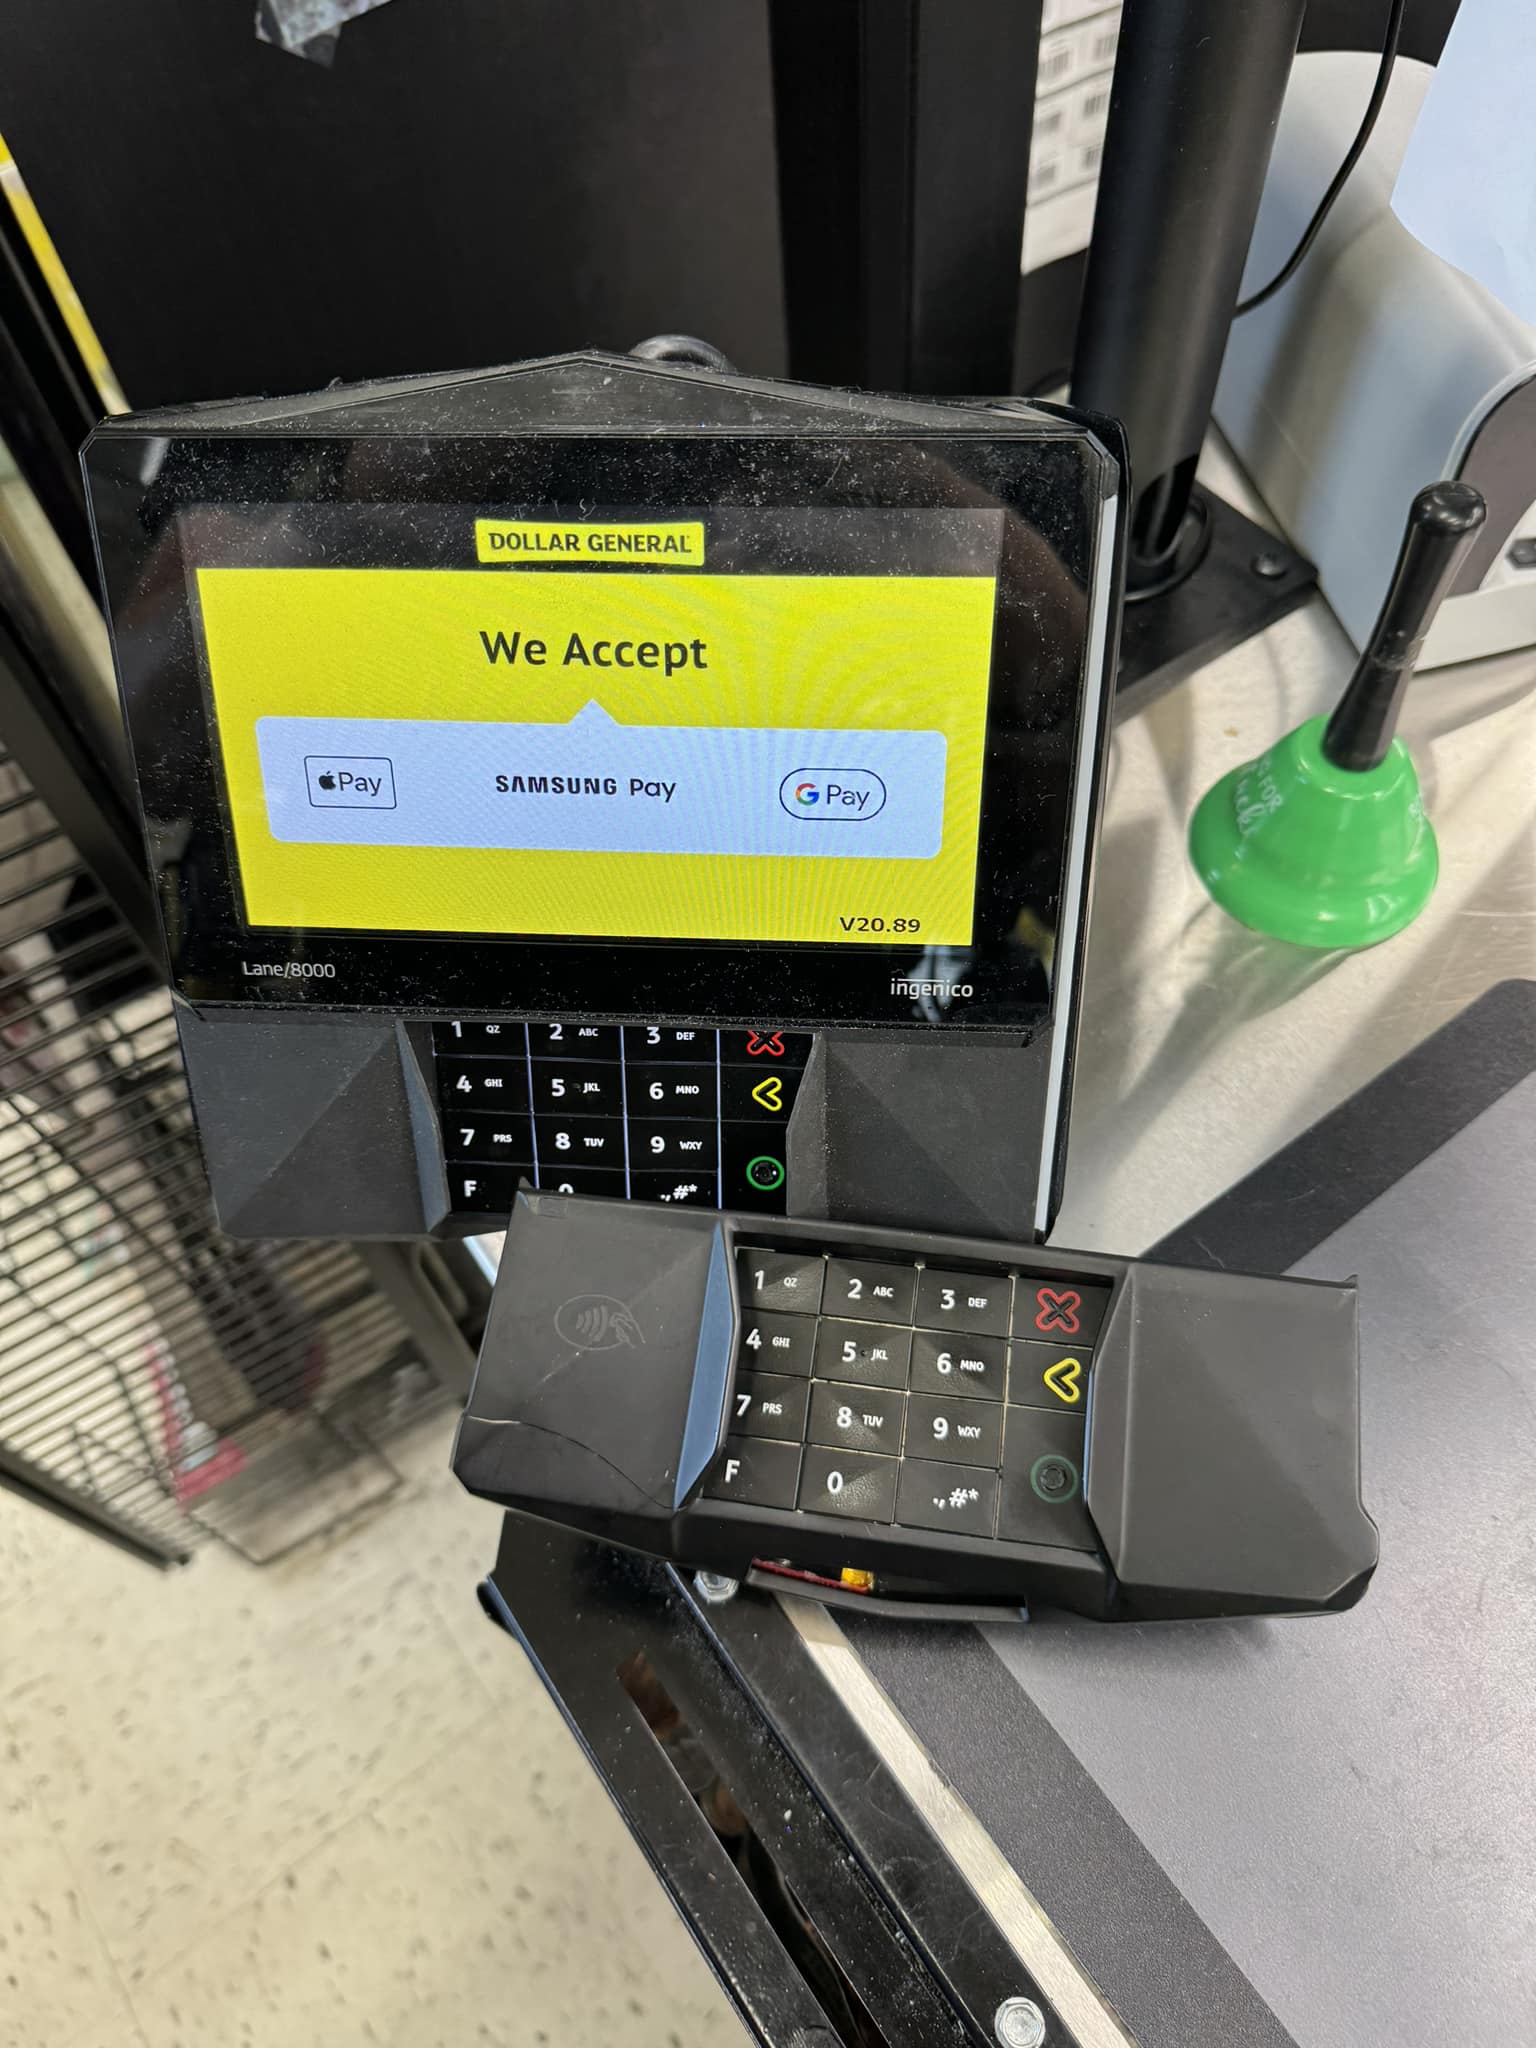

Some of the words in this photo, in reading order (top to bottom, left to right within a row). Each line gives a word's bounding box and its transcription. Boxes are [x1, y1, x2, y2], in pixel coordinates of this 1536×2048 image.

[489, 533, 580, 551] DOLLAR
[588, 534, 691, 553] GENERAL
[480, 631, 546, 665] We
[563, 633, 707, 676] Accept
[339, 772, 381, 796] Pay
[496, 775, 616, 795] SAMSUNG
[630, 779, 676, 802] Pay
[827, 785, 870, 811] Pay
[840, 917, 920, 932] V20.89
[243, 962, 335, 982] Lane/8000
[890, 977, 974, 1000] ingenico
[452, 1021, 461, 1037] 1
[486, 1025, 500, 1033] QZ
[550, 1023, 563, 1040] 2
[579, 1028, 598, 1036] ABC
[647, 1027, 660, 1044] 3
[677, 1032, 695, 1040] DEF
[457, 1075, 472, 1092] 4
[485, 1079, 502, 1087] GHI
[552, 1079, 565, 1096] 5
[583, 1083, 600, 1093] JKL
[650, 1083, 663, 1099] 6
[676, 1086, 699, 1094] MNO
[461, 1129, 474, 1145] 7
[494, 1134, 512, 1142] PRS
[556, 1133, 570, 1149] 8
[584, 1138, 604, 1146] TUV
[651, 1136, 665, 1153] 9
[680, 1141, 702, 1150] WXY
[464, 1180, 476, 1196] F
[755, 1270, 764, 1290] 1
[784, 1277, 797, 1287] QZ
[848, 1279, 862, 1299] 2
[873, 1286, 893, 1297] ABC
[941, 1289, 954, 1309] 3
[968, 1298, 987, 1308] DEF
[746, 1329, 761, 1349] 4
[773, 1337, 790, 1348] GHI
[842, 1341, 856, 1362] 5
[871, 1349, 888, 1360] JKL
[937, 1353, 951, 1374] 6
[960, 1360, 984, 1371] MNO
[737, 1395, 751, 1416] 7
[763, 1403, 782, 1414] PRS
[837, 1407, 852, 1428] 8
[863, 1415, 883, 1427] TUV
[934, 1417, 948, 1439] 9
[958, 1426, 980, 1438] WXY
[725, 1460, 740, 1482] F
[828, 1472, 843, 1495] 0
